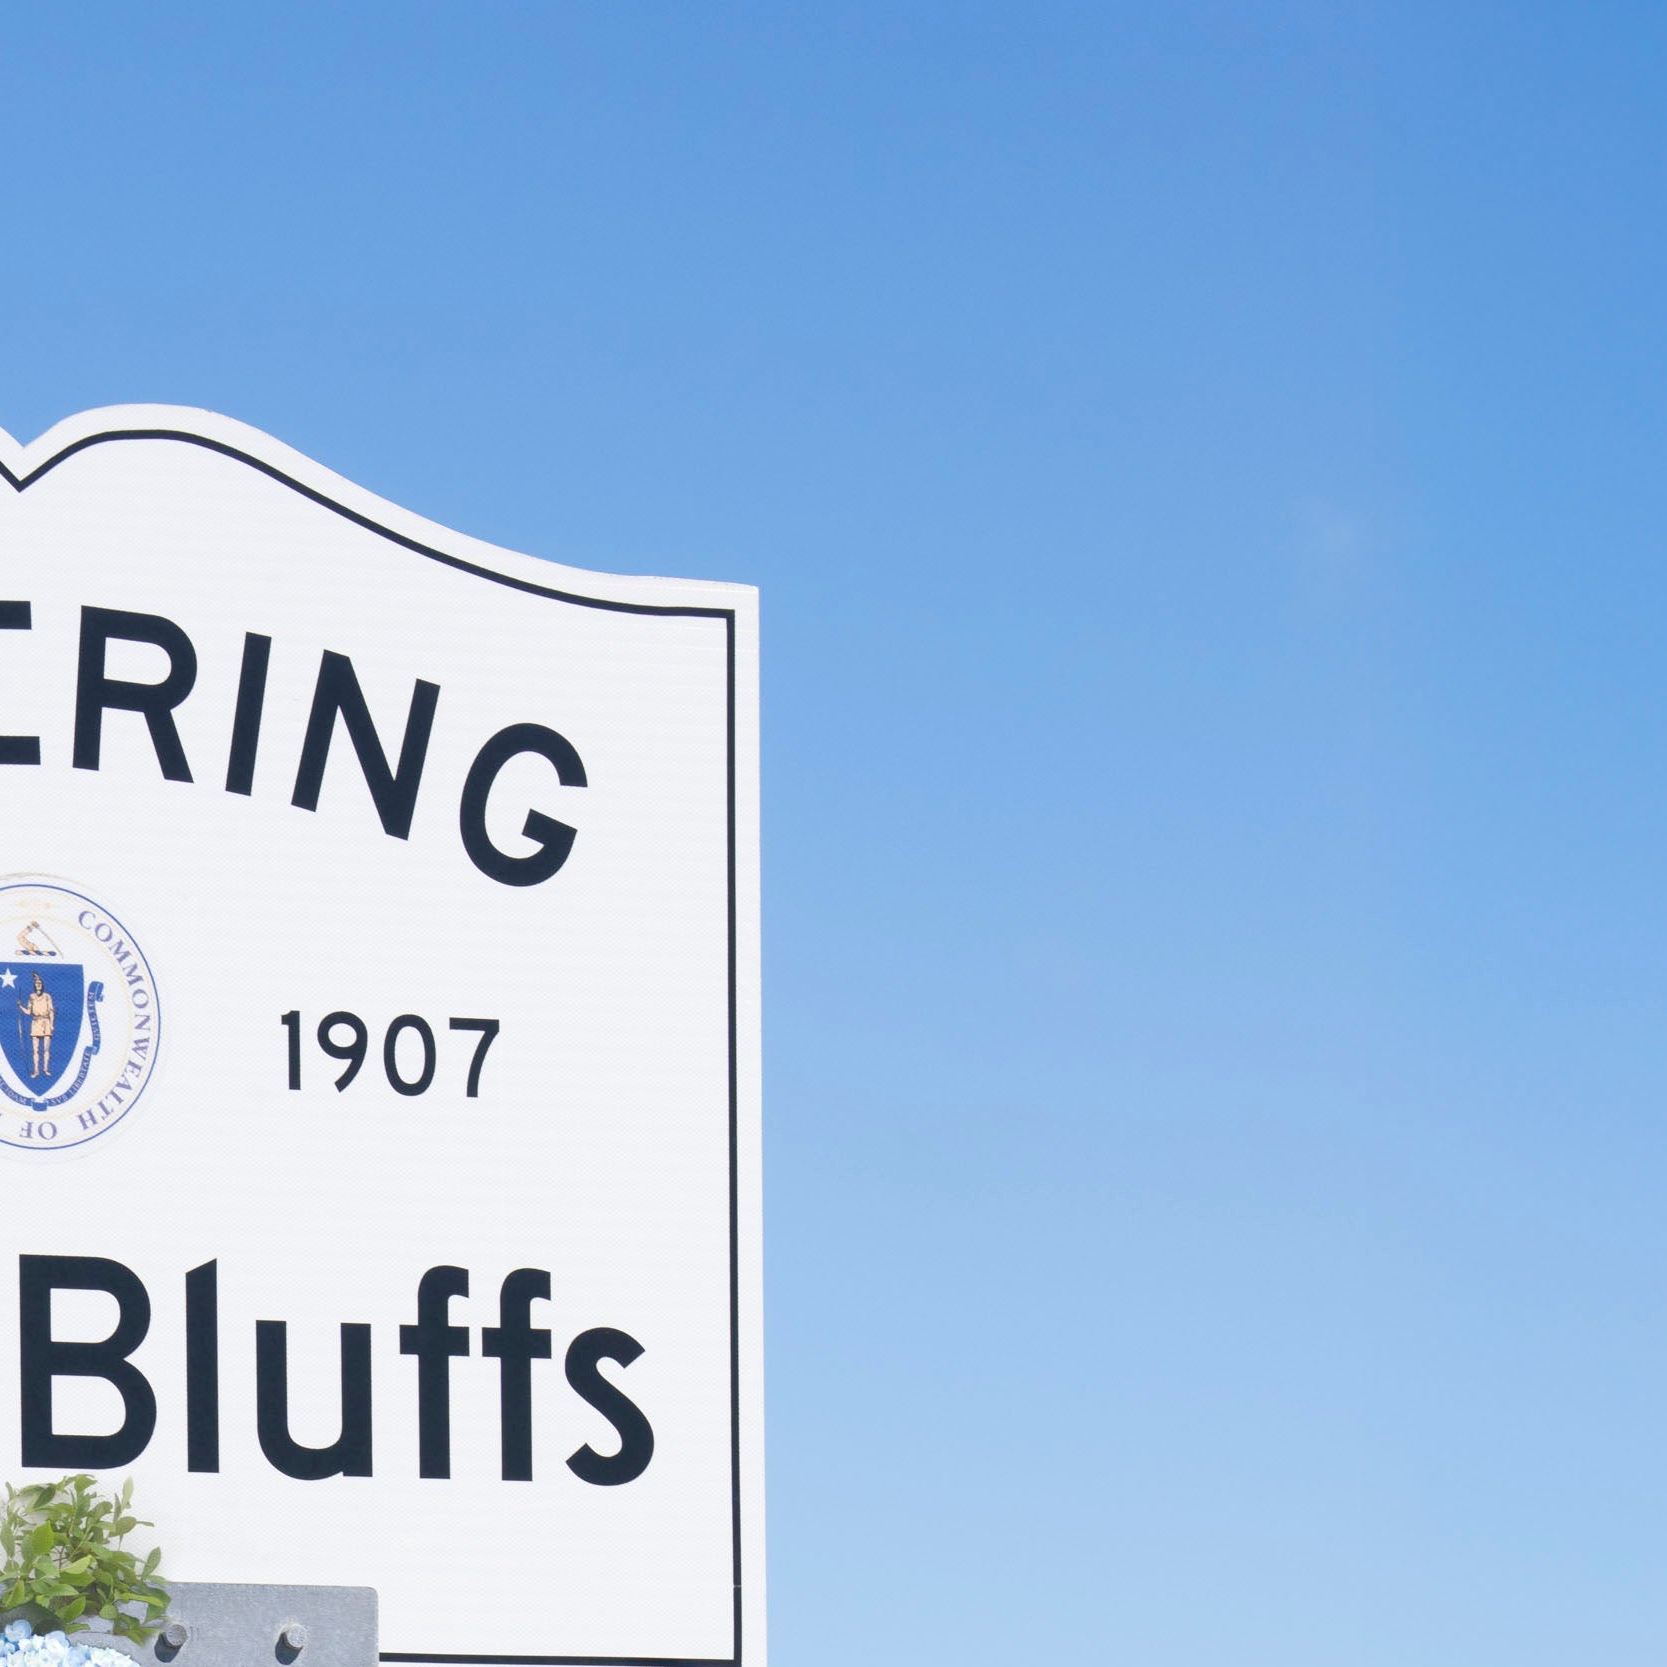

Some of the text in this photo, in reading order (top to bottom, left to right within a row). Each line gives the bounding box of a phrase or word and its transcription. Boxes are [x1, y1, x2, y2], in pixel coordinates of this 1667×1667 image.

[77, 910, 150, 1131] COMMONWEALTH
[282, 1011, 499, 1097] 1907
[19, 1121, 57, 1140] OF
[20, 1255, 654, 1486] Bluffs
